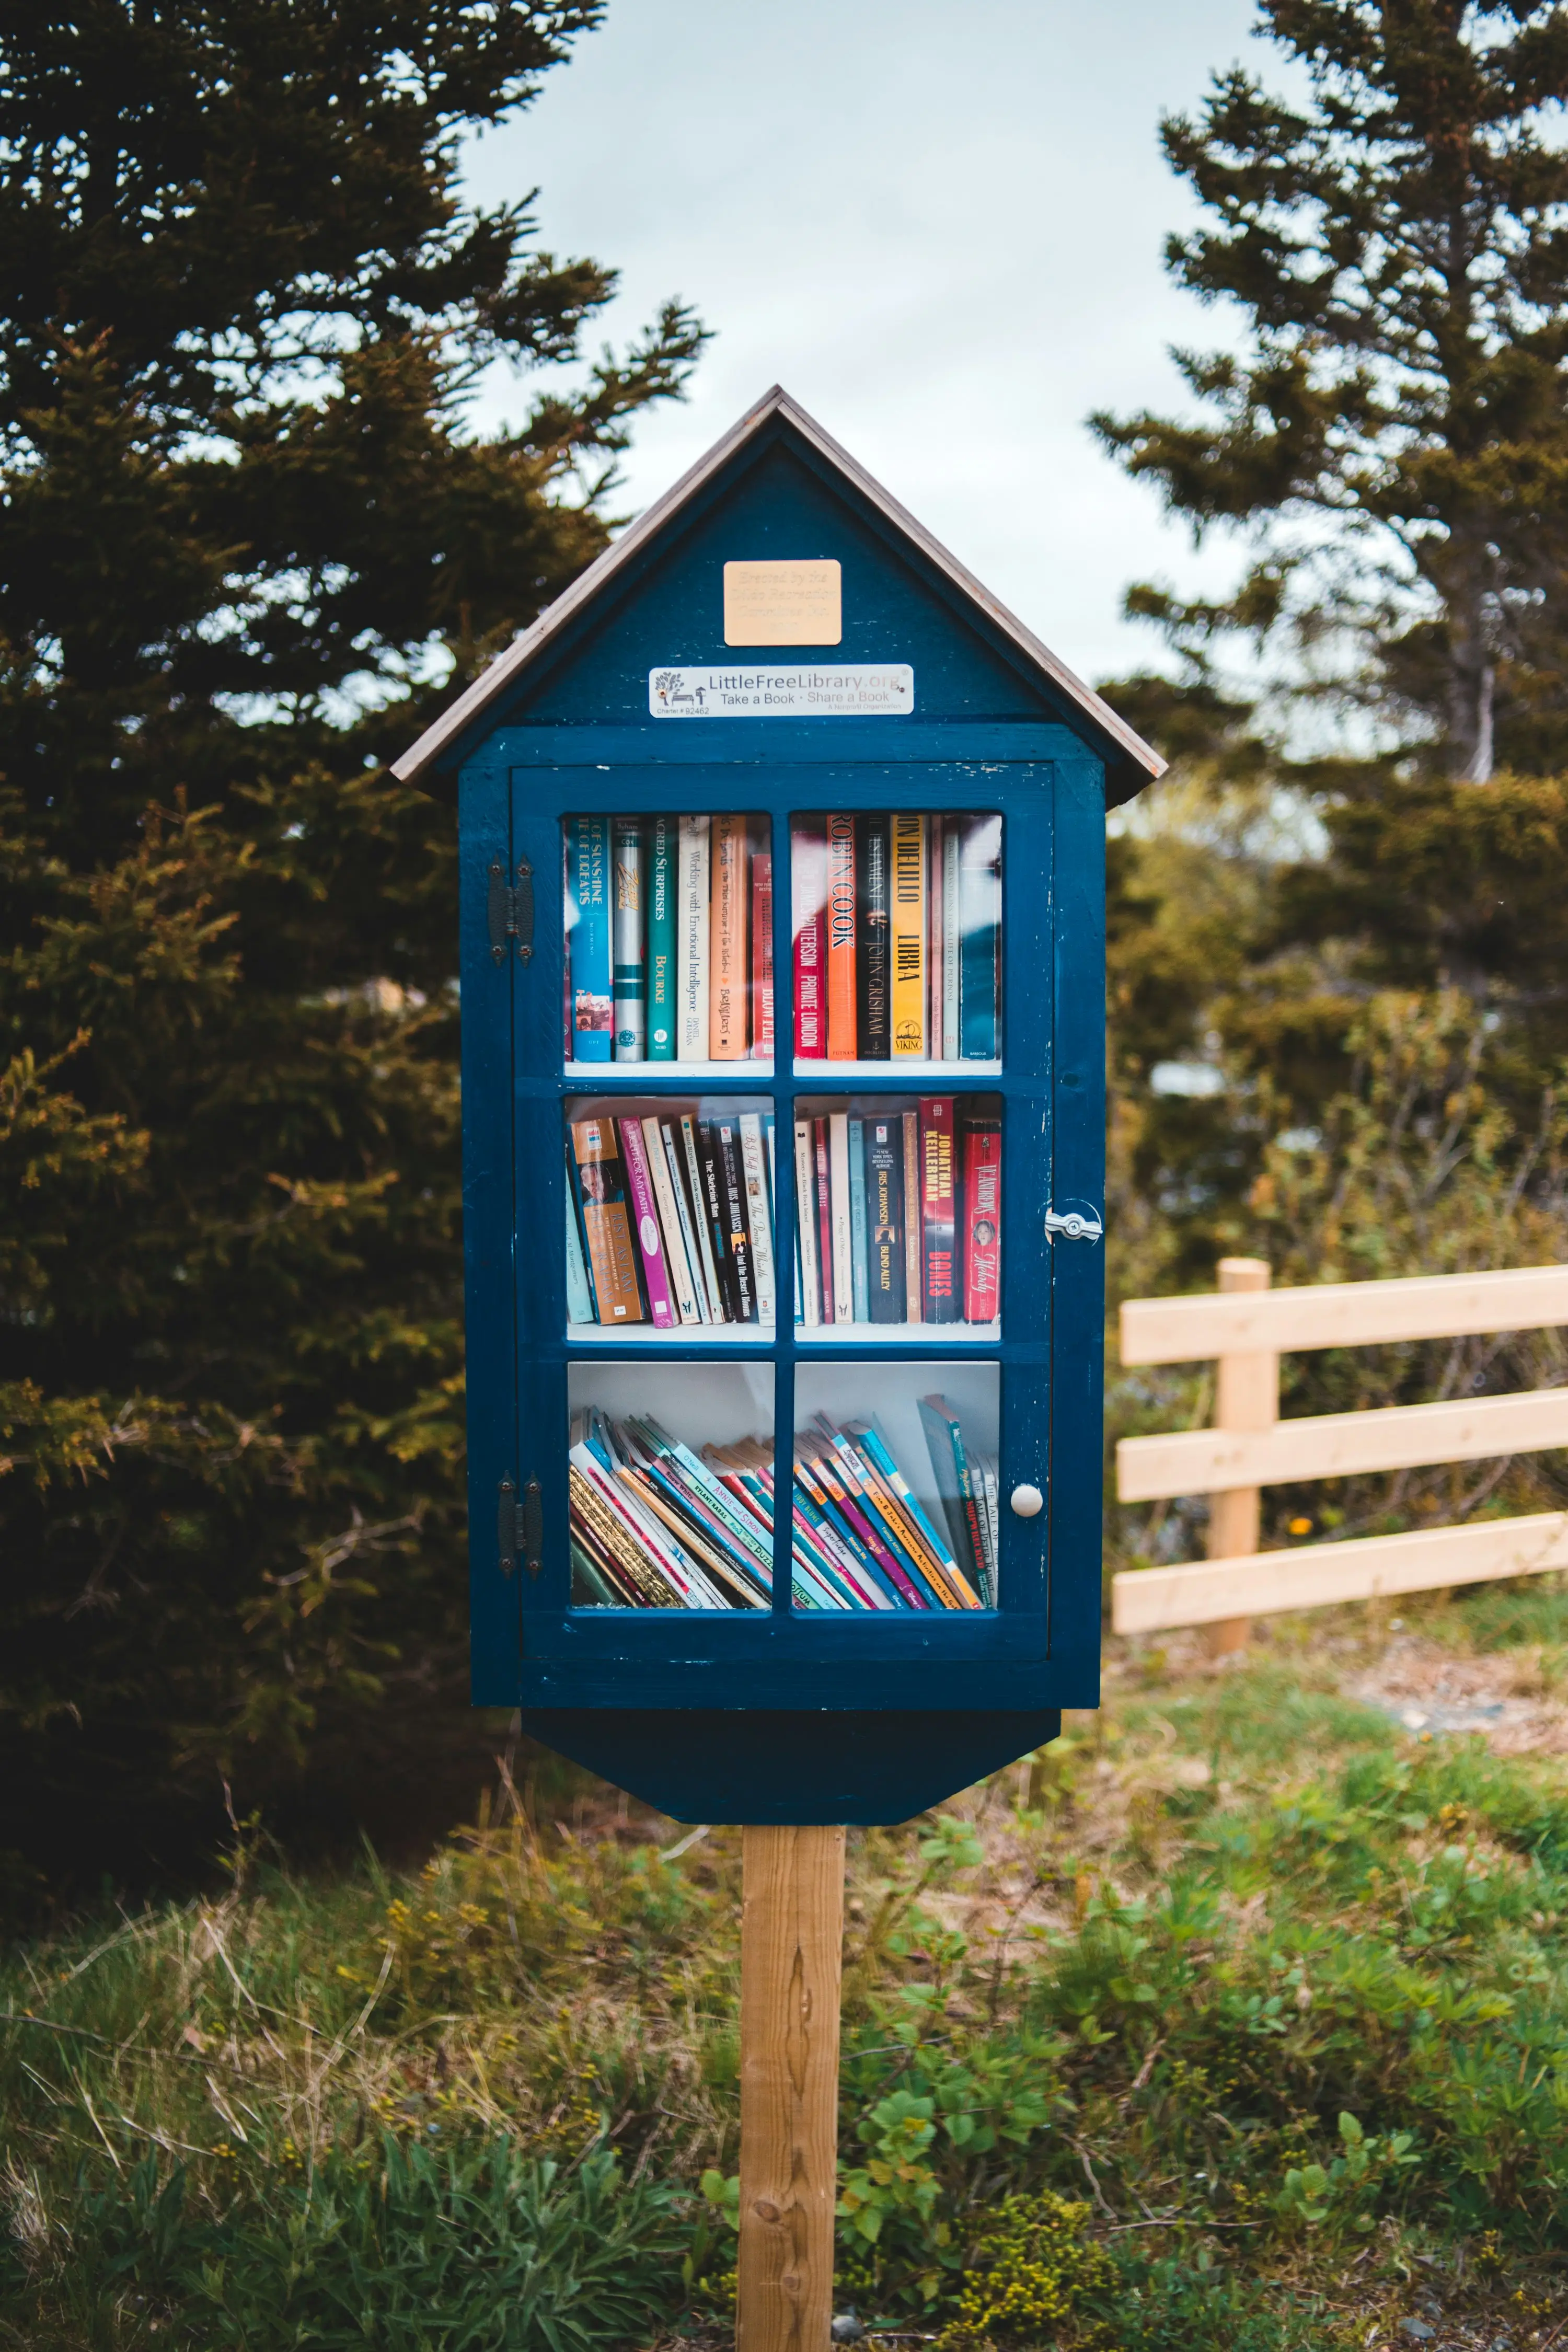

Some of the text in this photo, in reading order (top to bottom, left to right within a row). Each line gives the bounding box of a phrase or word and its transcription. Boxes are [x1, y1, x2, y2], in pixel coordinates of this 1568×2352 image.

[710, 673, 900, 690] LittleFreeLibrary.org
[721, 694, 748, 705] Take
[765, 694, 794, 704] Book
[808, 692, 843, 703] Share
[859, 691, 889, 702] Book
[591, 825, 601, 841] OF
[579, 835, 590, 905] OF DREAMS
[655, 858, 667, 920] SURPRISES
[831, 882, 855, 950] COOK
[897, 843, 920, 982] DELILLO LIBRA
[686, 851, 700, 1012] Working with Emotional Intelligence
[801, 916, 816, 966] PATTERSON
[865, 942, 883, 974] JOHN
[948, 956, 953, 966] OF
[655, 955, 667, 1004] BOURKE
[801, 975, 817, 1009] PRIVATE
[869, 979, 883, 1034] GRISHAM
[801, 1012, 817, 1047] LONDON
[895, 1040, 923, 1050] VIKING
[632, 1158, 642, 1174] FOR
[745, 1153, 759, 1170] Hoff
[926, 1131, 938, 1201] KELLERMAN
[938, 1135, 951, 1197] JONATHAN
[635, 1176, 643, 1190] MY
[707, 1173, 717, 1202] Skeleton
[974, 1176, 997, 1214] ANDREWS
[638, 1191, 649, 1214] PATH
[711, 1203, 719, 1218] Man
[751, 1202, 764, 1218] The
[752, 1221, 765, 1249] Penny
[878, 1171, 890, 1291] IRIS JOHANSEN BLIND ALLEY
[607, 1231, 619, 1282] AUTOBIOGRAPHY
[728, 1187, 751, 1317] IRIS JOHANSEN And the Desert Blooms
[621, 1272, 633, 1293] AM
[929, 1252, 952, 1296] BONES
[972, 1252, 996, 1294] Melody
[684, 1455, 699, 1471] O'Neill
[628, 1473, 651, 1495] HALFBRICK
[666, 1471, 679, 1486] Snow
[679, 1484, 693, 1500] White
[986, 1481, 995, 1500] THE
[713, 1486, 761, 1536] ANNIE and SIMON
[795, 1493, 821, 1523] JUDY BLUME
[988, 1502, 998, 1526] TALE
[822, 1526, 847, 1557] Superfudge
[848, 1536, 862, 1553] Rescue
[867, 1536, 878, 1549] Step
[873, 1491, 882, 1504] Finn
[887, 1510, 901, 1529] Jake's
[900, 1528, 917, 1553] Awesome
[918, 1554, 937, 1584] Activities
[881, 1526, 902, 1554] Family Affair
[966, 1501, 985, 1569] SHIPWRECKED
[972, 1478, 994, 1592] THE TALE OF PETER RABBIT
[684, 1528, 751, 1591] FRUIT FRENZY FORCE
[892, 1594, 901, 1607] Disney
[908, 1590, 918, 1605] Disney
